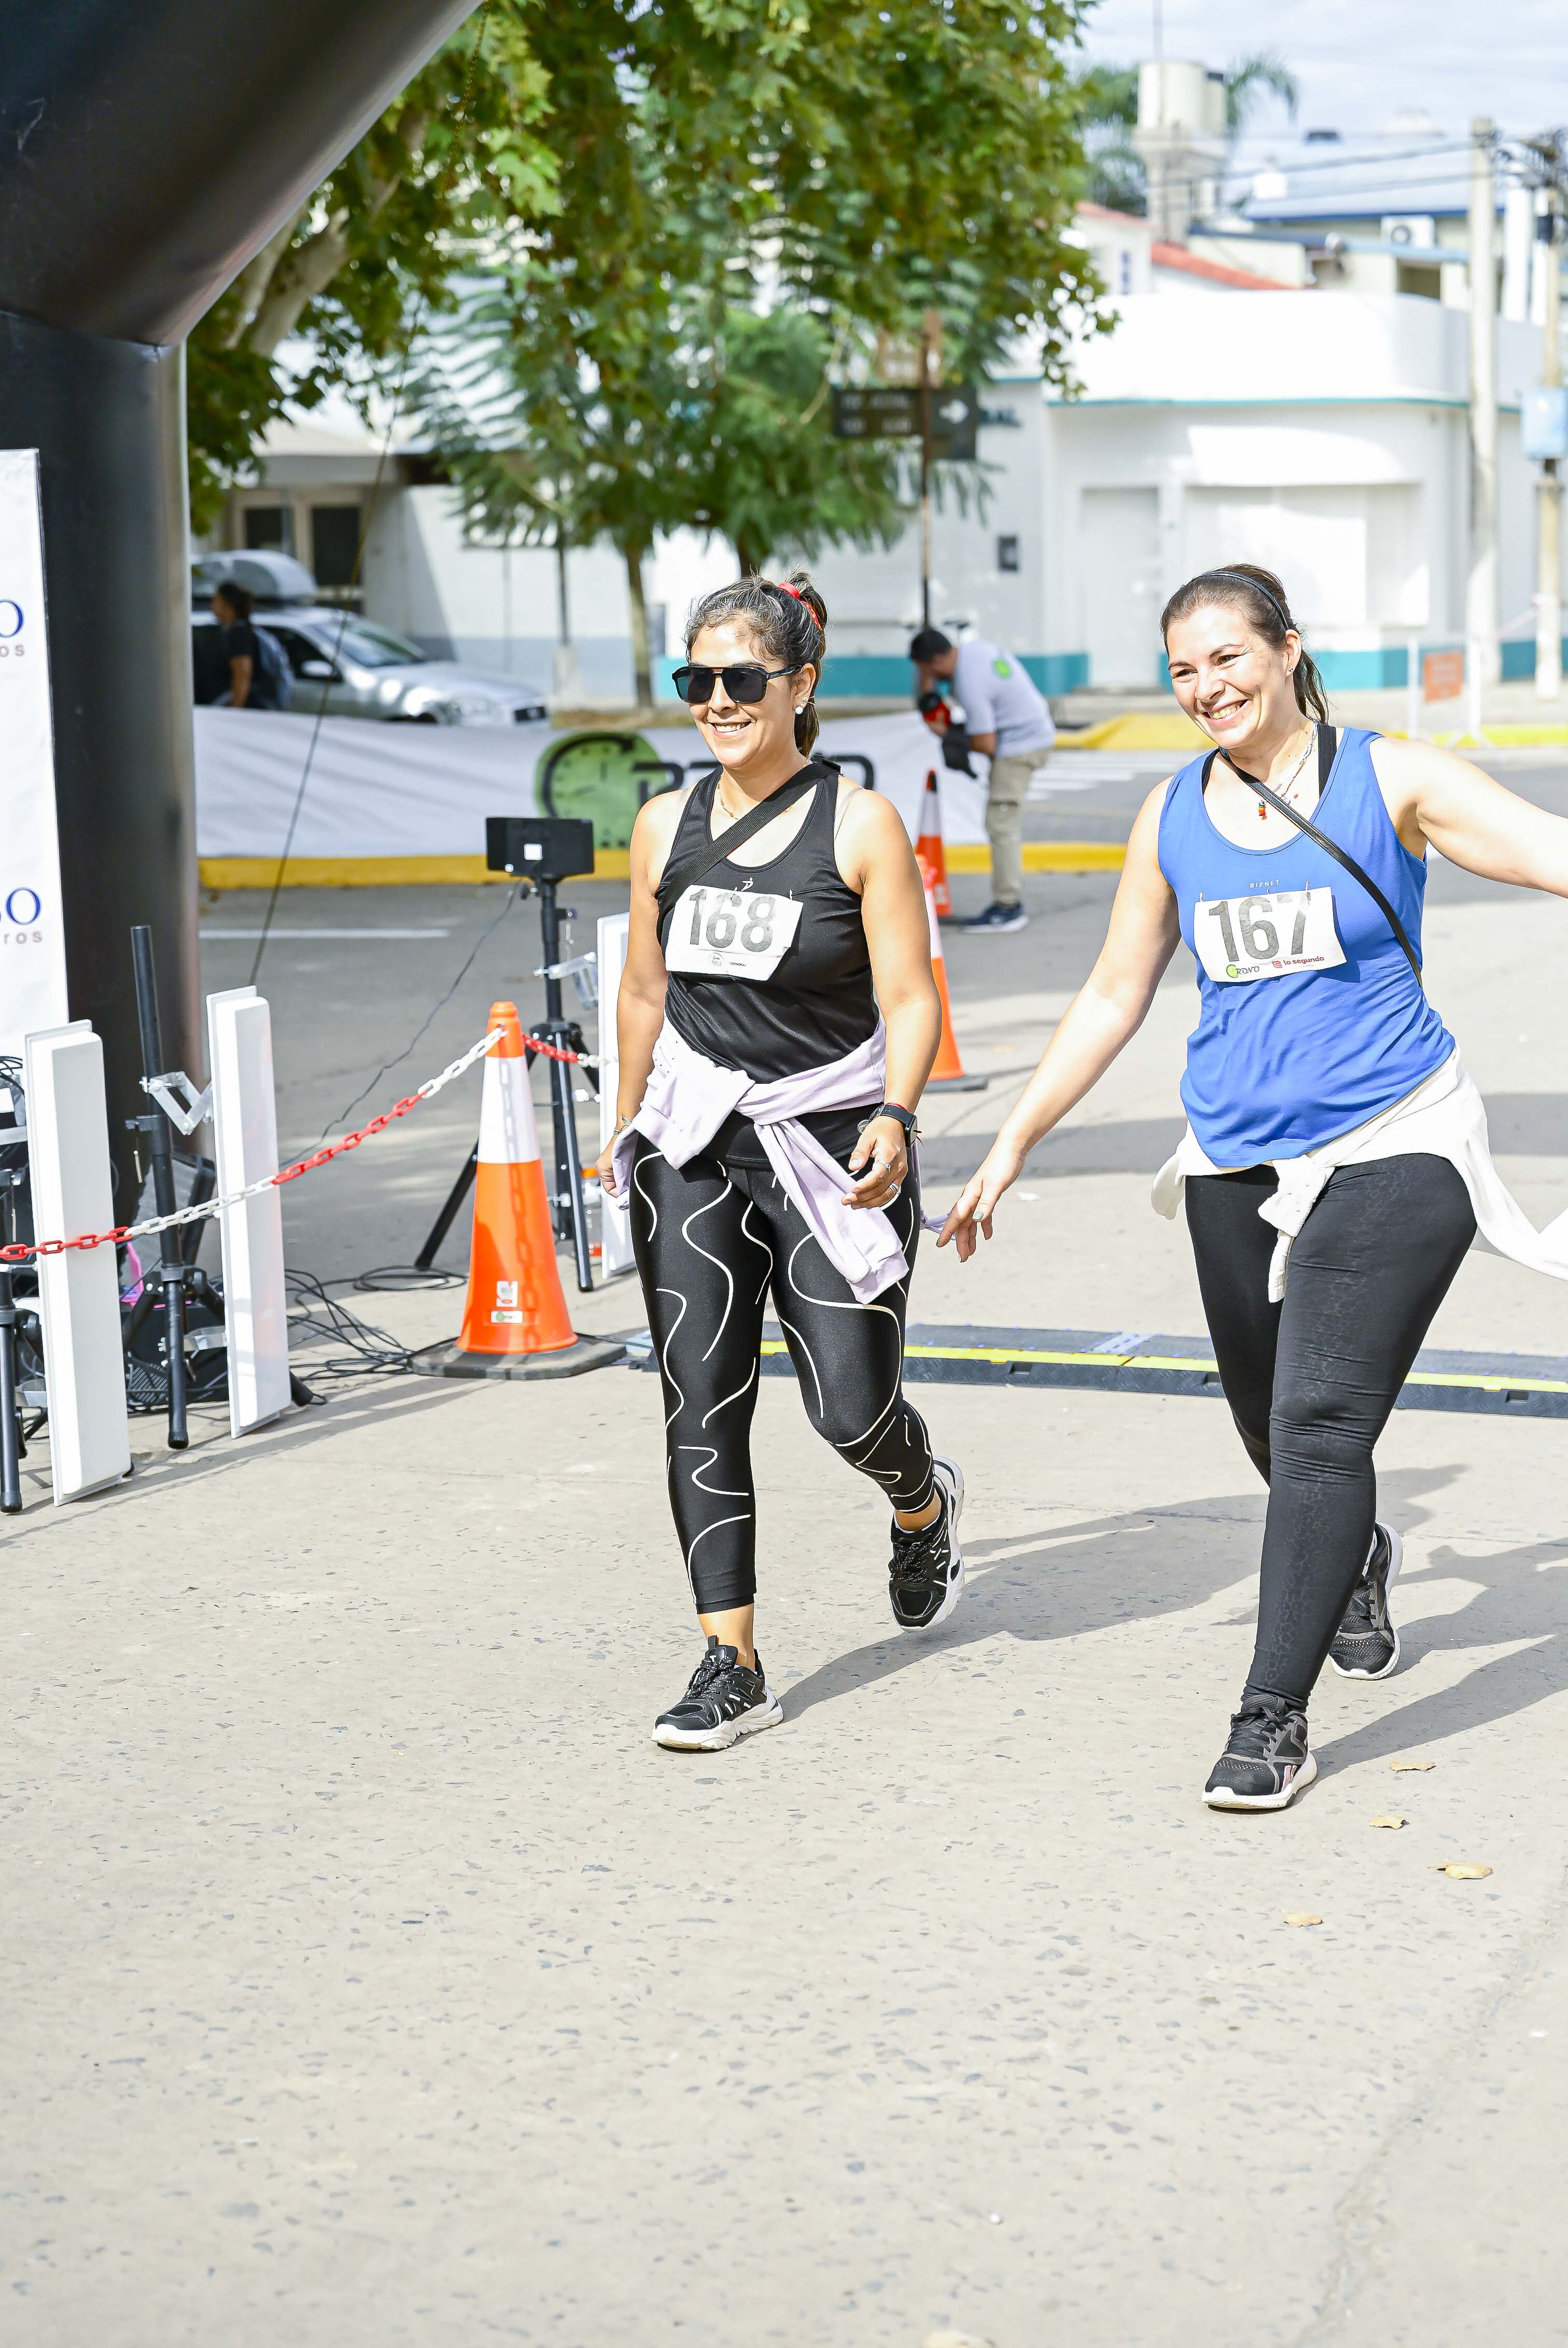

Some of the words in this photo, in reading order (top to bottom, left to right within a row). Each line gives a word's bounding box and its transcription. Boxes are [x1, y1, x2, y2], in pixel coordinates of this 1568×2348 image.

[1250, 879, 1280, 888] BIZNET
[0, 887, 41, 925] O
[689, 889, 776, 952] 168
[1209, 892, 1311, 962] 167
[1293, 956, 1324, 966] segunda
